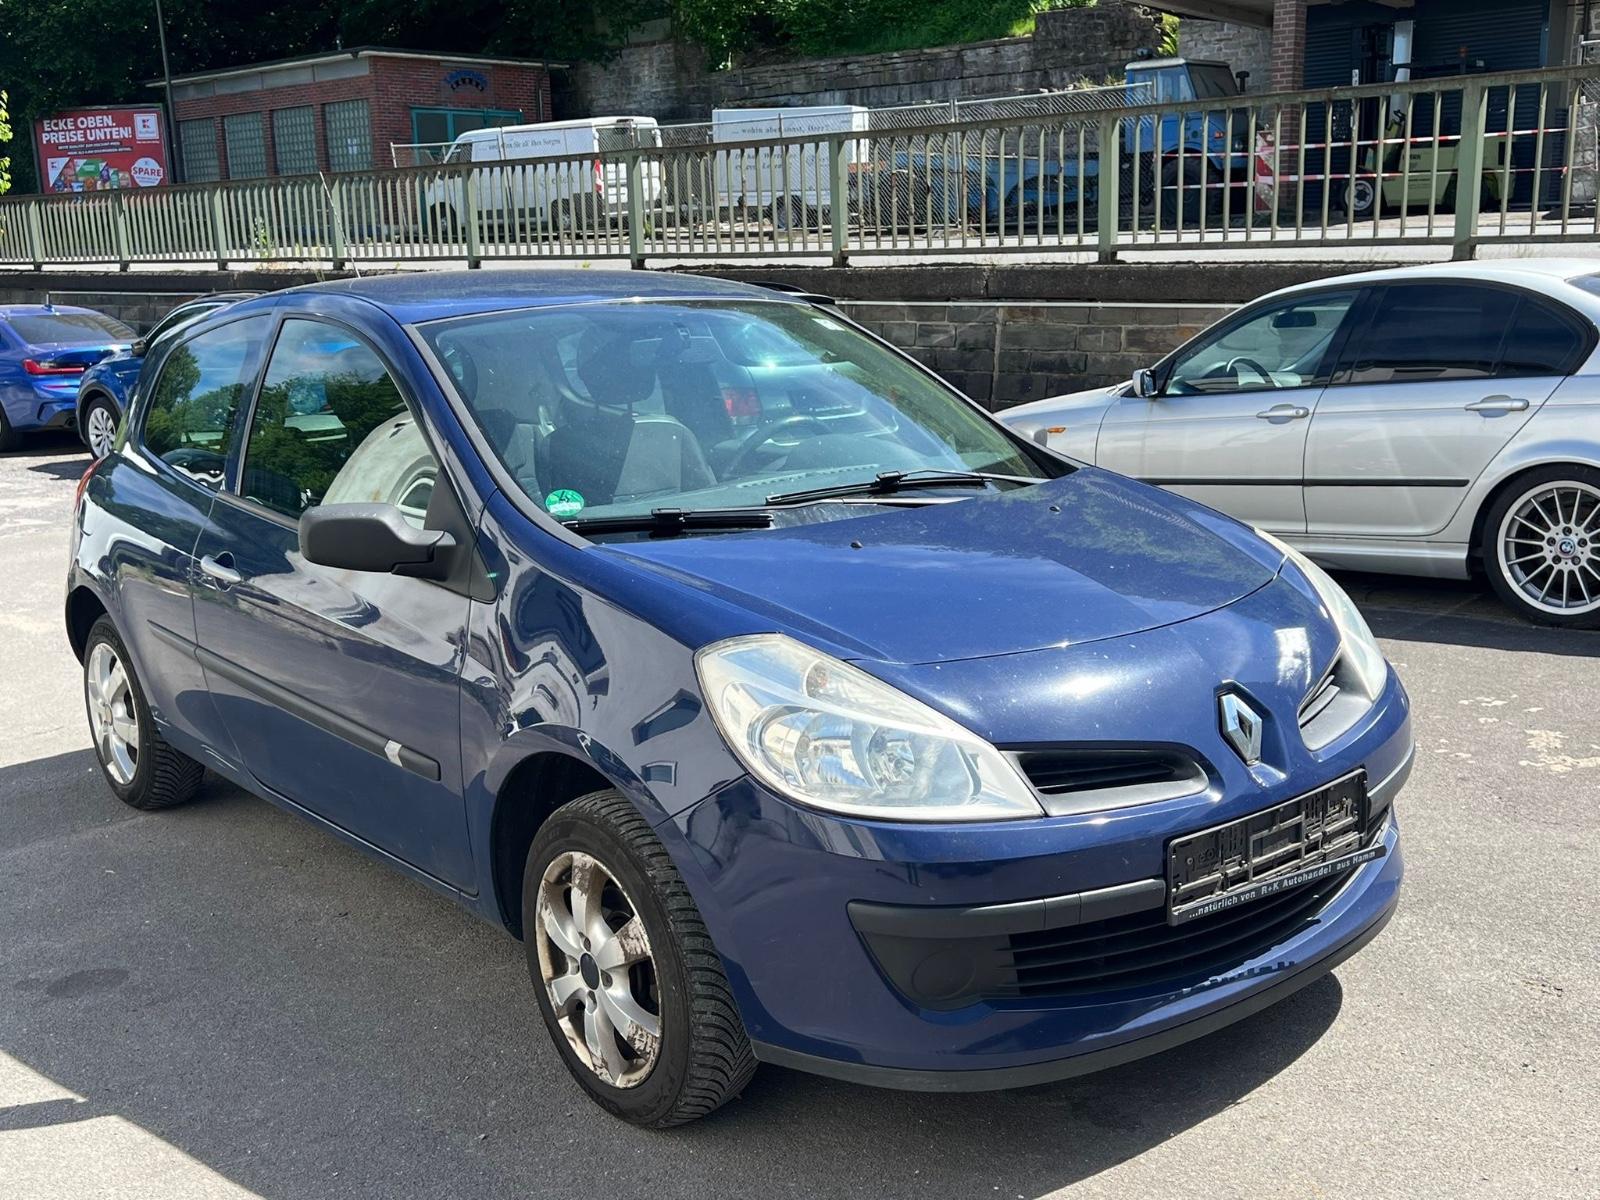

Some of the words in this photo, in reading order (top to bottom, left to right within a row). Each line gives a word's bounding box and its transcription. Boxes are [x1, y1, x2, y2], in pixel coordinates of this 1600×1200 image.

[43, 118, 75, 132] ECKE
[77, 115, 116, 129] OBEN.
[42, 130, 85, 144] PREISE
[86, 126, 132, 141] UNTEN!
[132, 166, 162, 177] SPARE
[1189, 896, 1238, 918] ...natürlich
[1241, 890, 1256, 904] von
[1261, 880, 1279, 895] R+K
[1283, 865, 1332, 888] Autohandel
[1336, 860, 1351, 871] aus
[1352, 850, 1376, 866] Hamm
